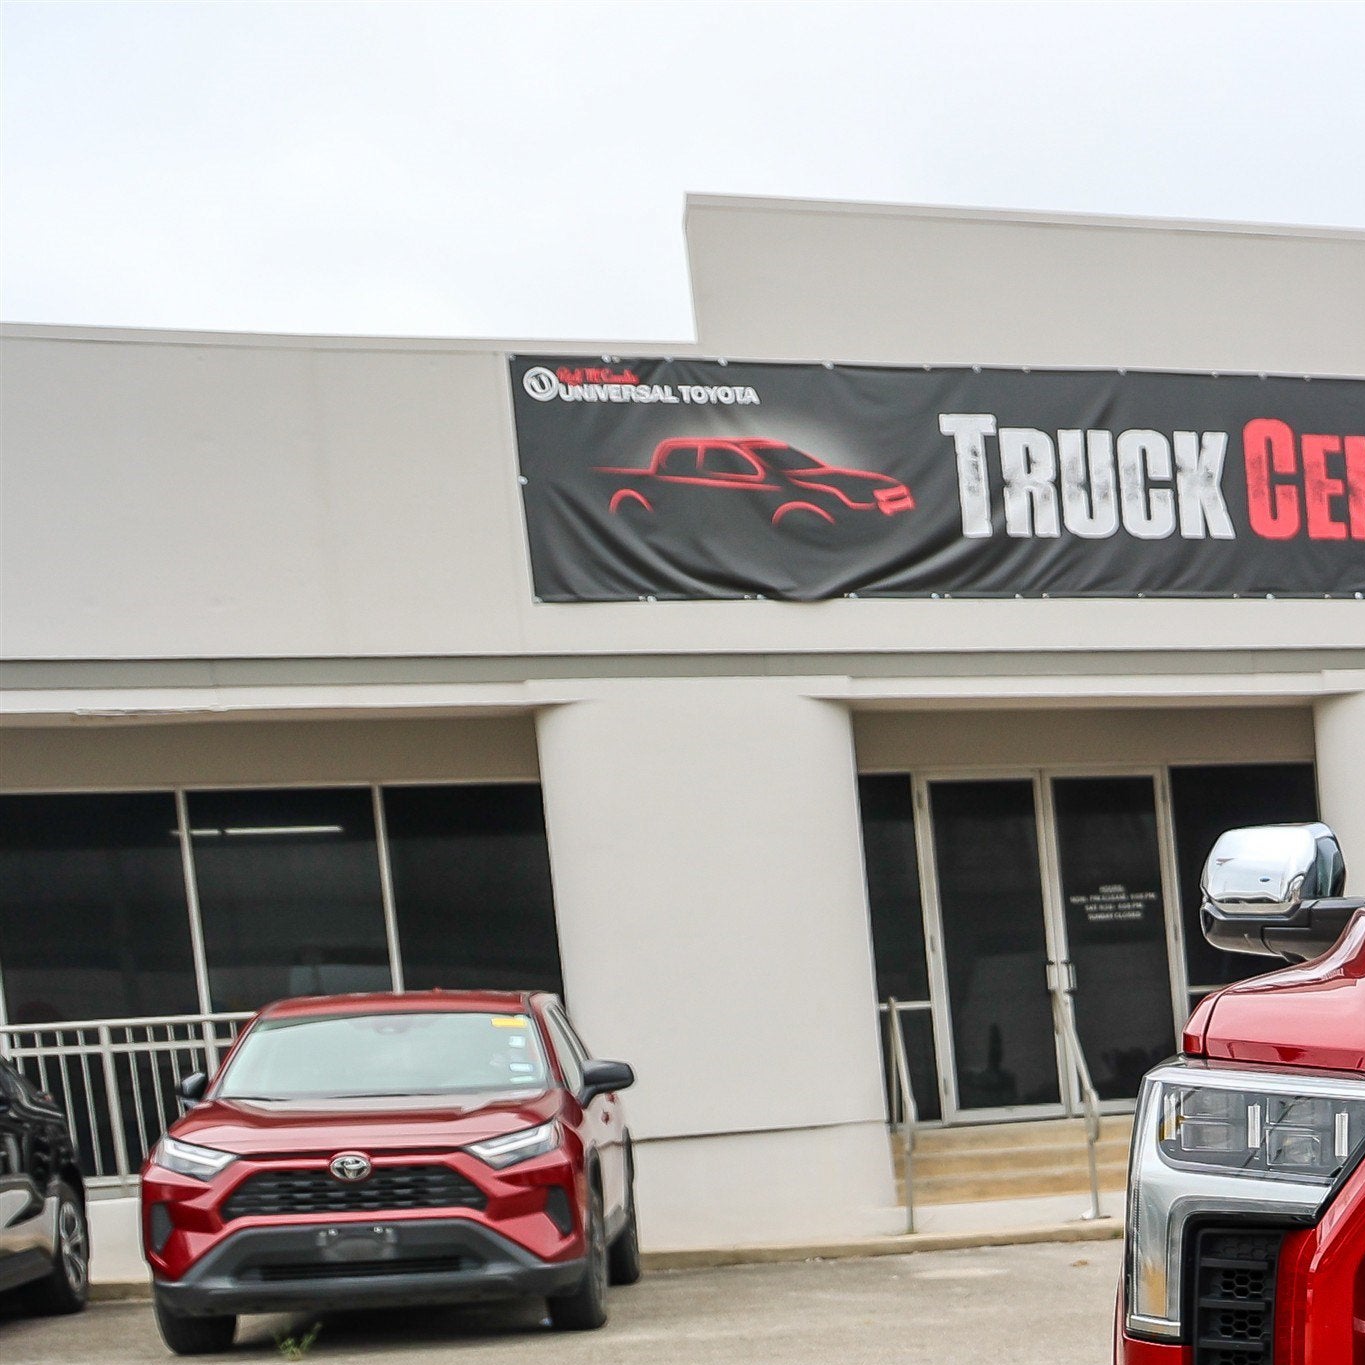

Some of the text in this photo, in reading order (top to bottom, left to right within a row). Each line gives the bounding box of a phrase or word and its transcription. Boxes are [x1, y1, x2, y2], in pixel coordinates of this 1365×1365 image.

[558, 384, 760, 405] UNIVERSAL TOYOTA
[938, 413, 1236, 541] TRUCK
